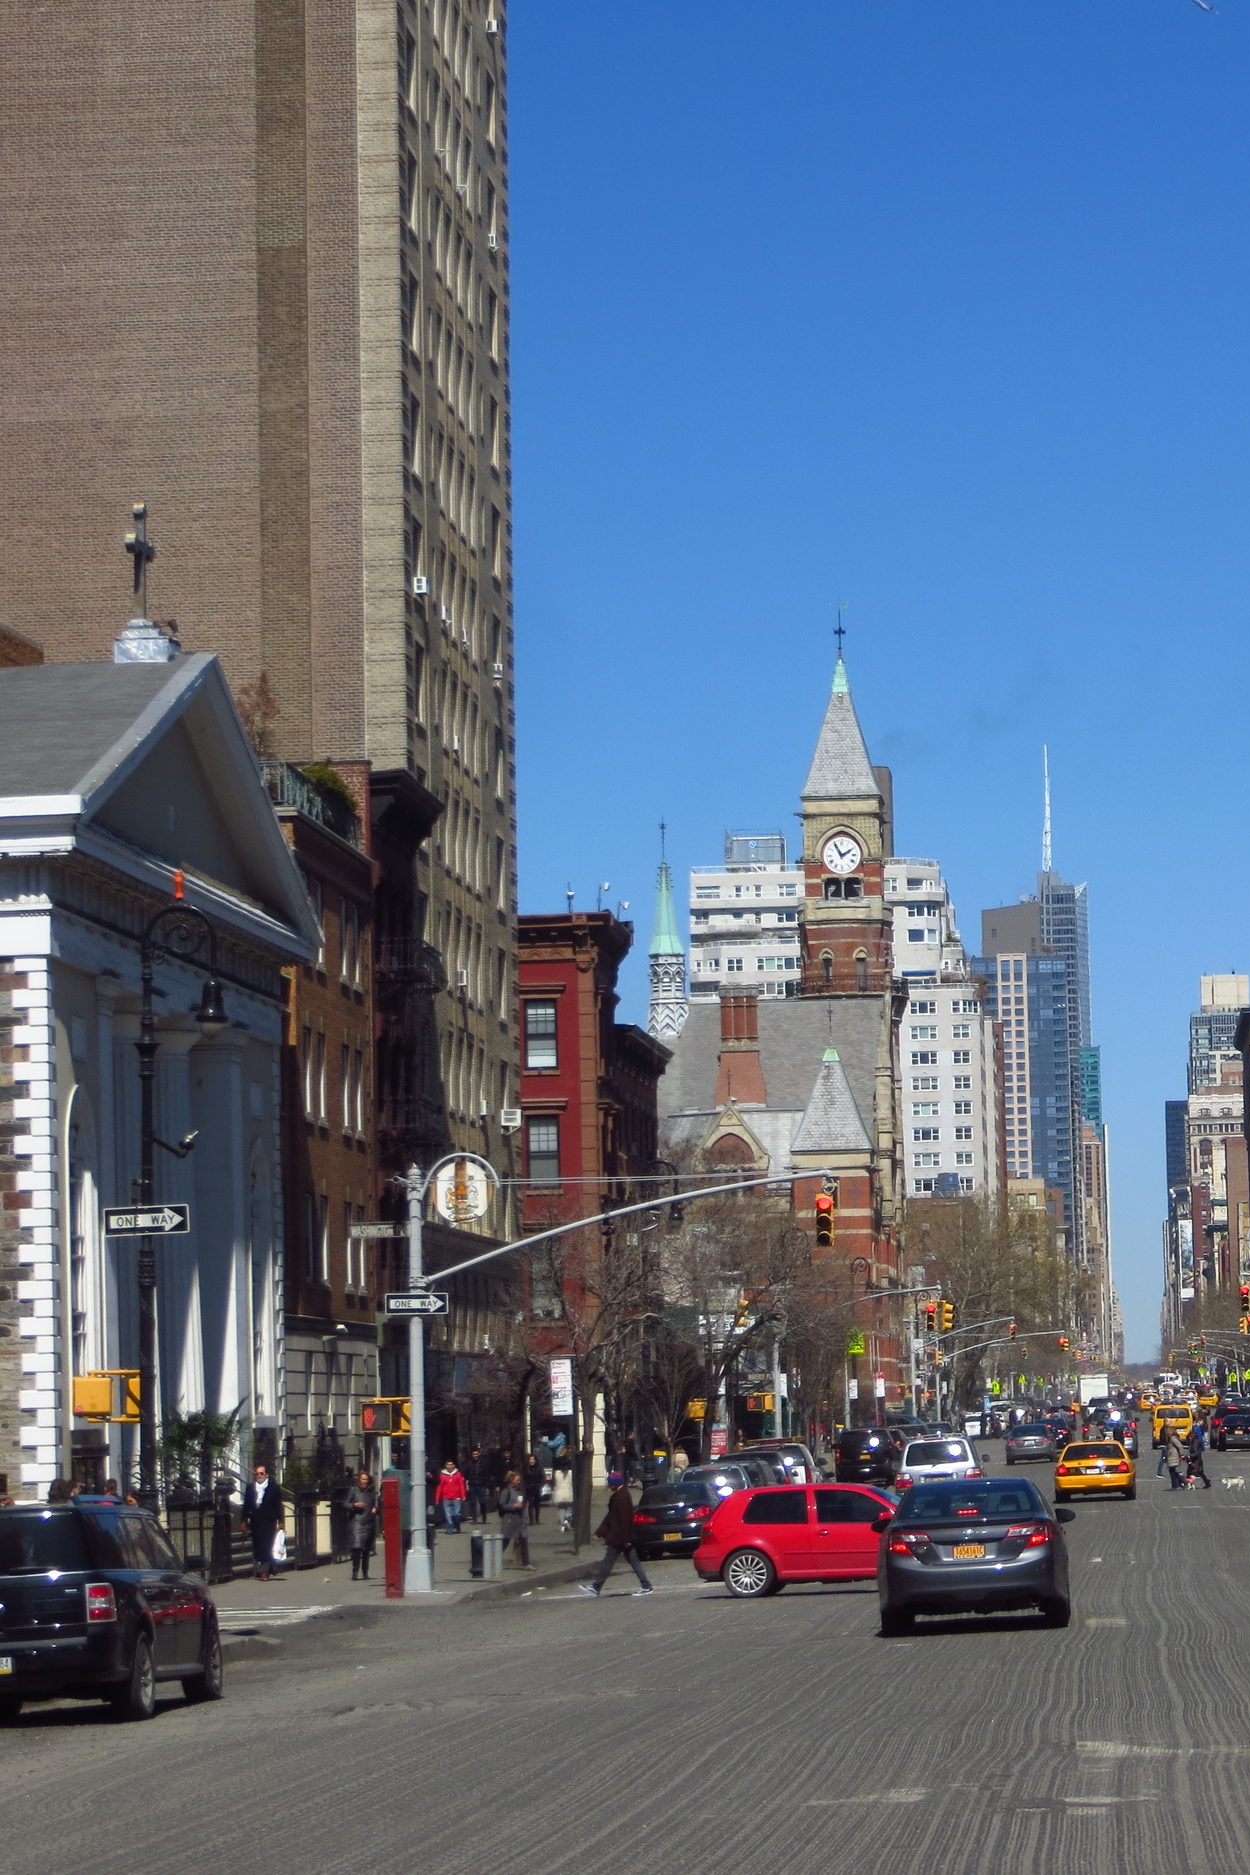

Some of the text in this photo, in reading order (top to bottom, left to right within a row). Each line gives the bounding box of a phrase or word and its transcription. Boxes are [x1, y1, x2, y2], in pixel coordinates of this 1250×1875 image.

[116, 1214, 175, 1228] ONE WAY
[350, 1224, 394, 1238] WASHINGTON
[394, 1299, 439, 1308] ONE WAY
